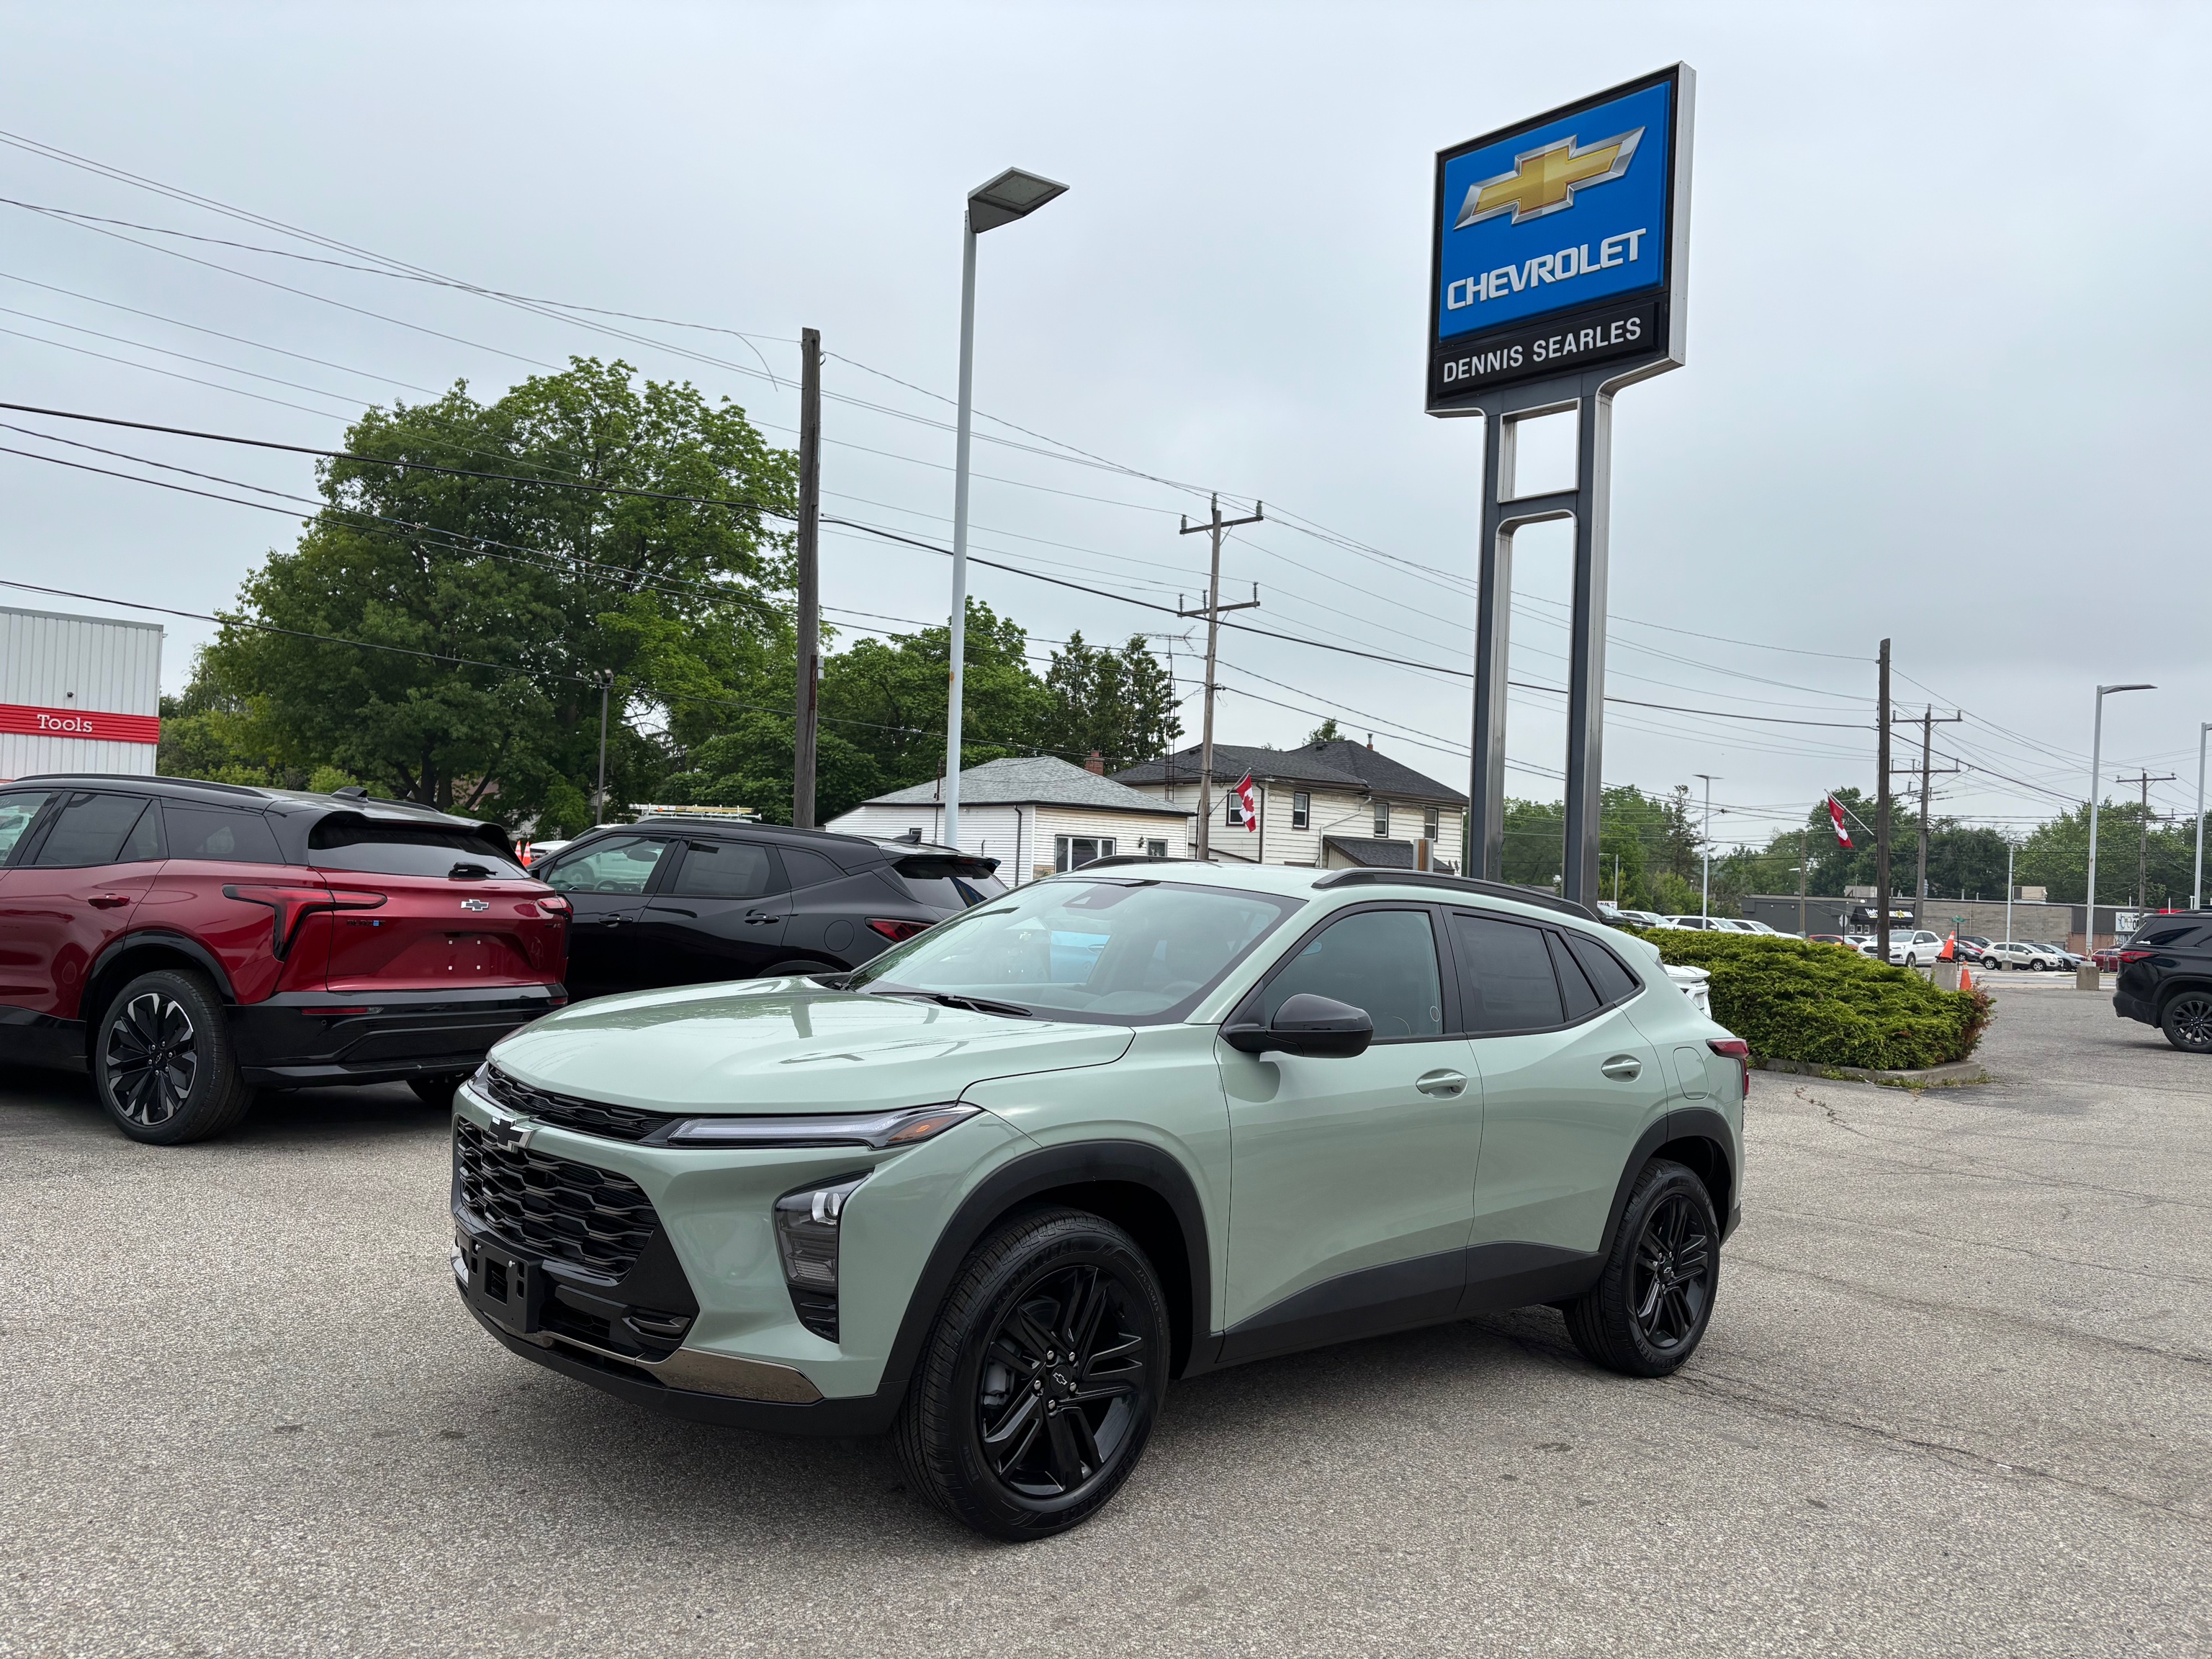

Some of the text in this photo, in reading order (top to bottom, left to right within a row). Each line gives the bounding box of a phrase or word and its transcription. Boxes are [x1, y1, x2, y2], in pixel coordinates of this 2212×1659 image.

[1447, 228, 1647, 310] CHEVROLET
[1443, 317, 1642, 383] DENNIS SEARLES
[37, 714, 93, 733] Tools
